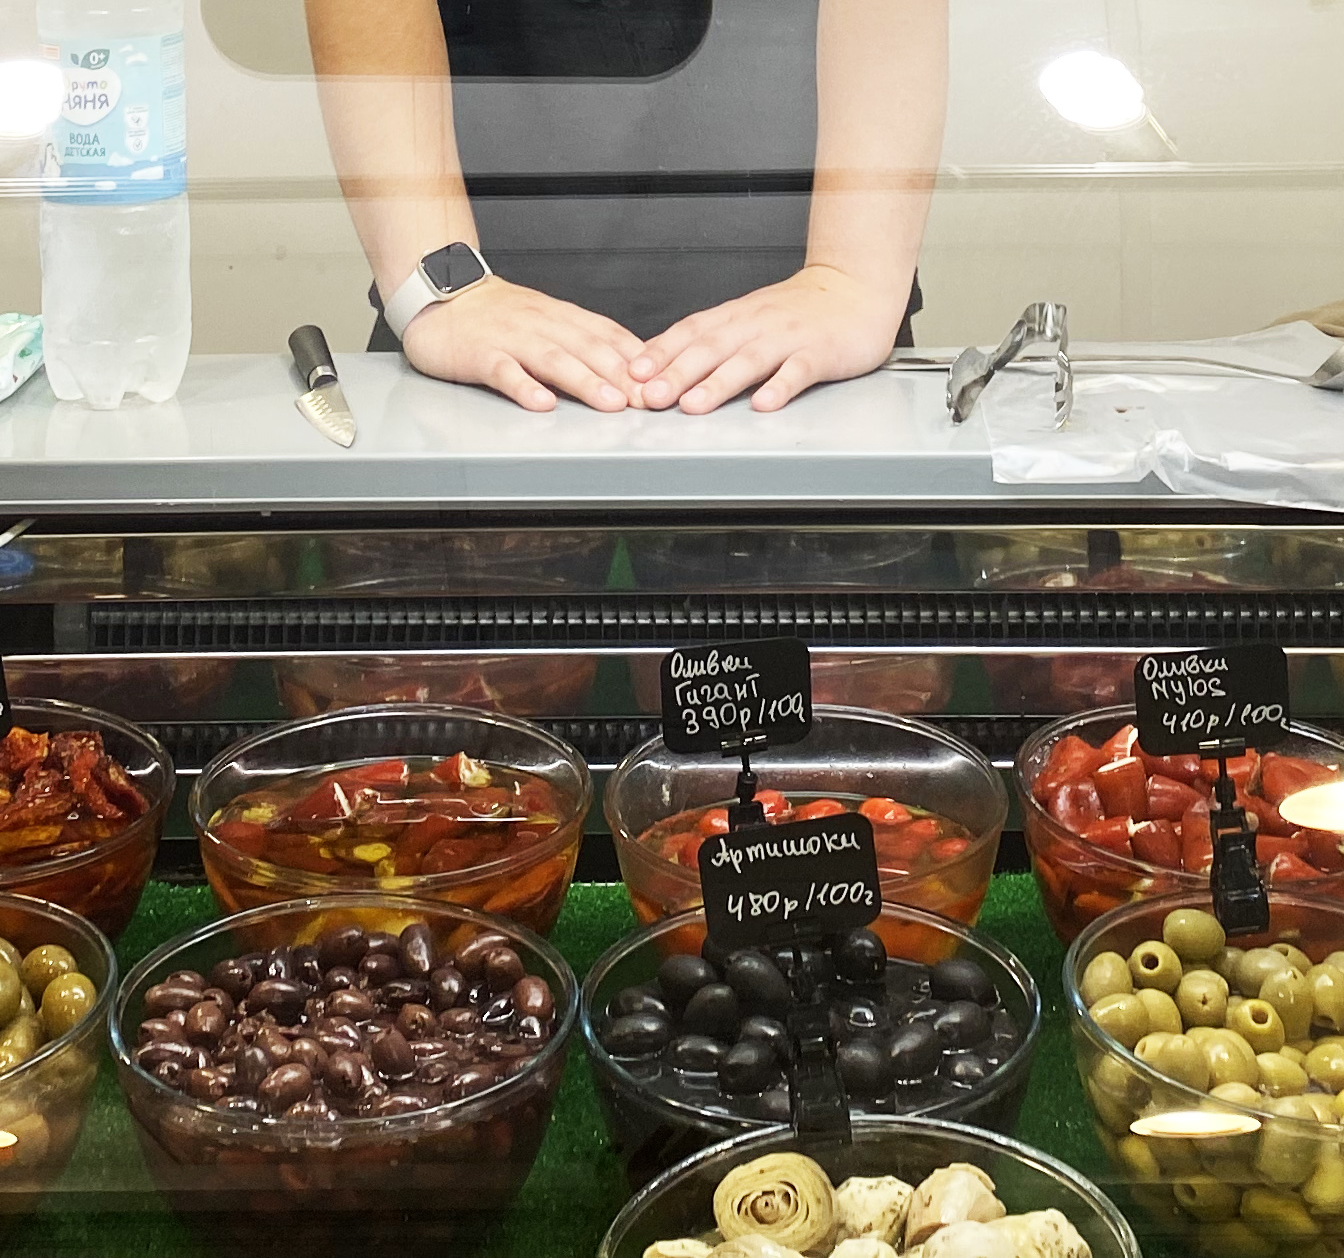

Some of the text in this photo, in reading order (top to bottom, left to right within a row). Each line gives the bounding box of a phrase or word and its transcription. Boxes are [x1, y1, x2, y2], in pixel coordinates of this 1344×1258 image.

[64, 146, 106, 158] ДЕТСКАЯ
[69, 132, 100, 146] ВОДА
[670, 650, 752, 678] Оливки
[1143, 654, 1229, 681] Оливки
[675, 673, 760, 706] Гигант
[711, 832, 861, 873] Артишоки
